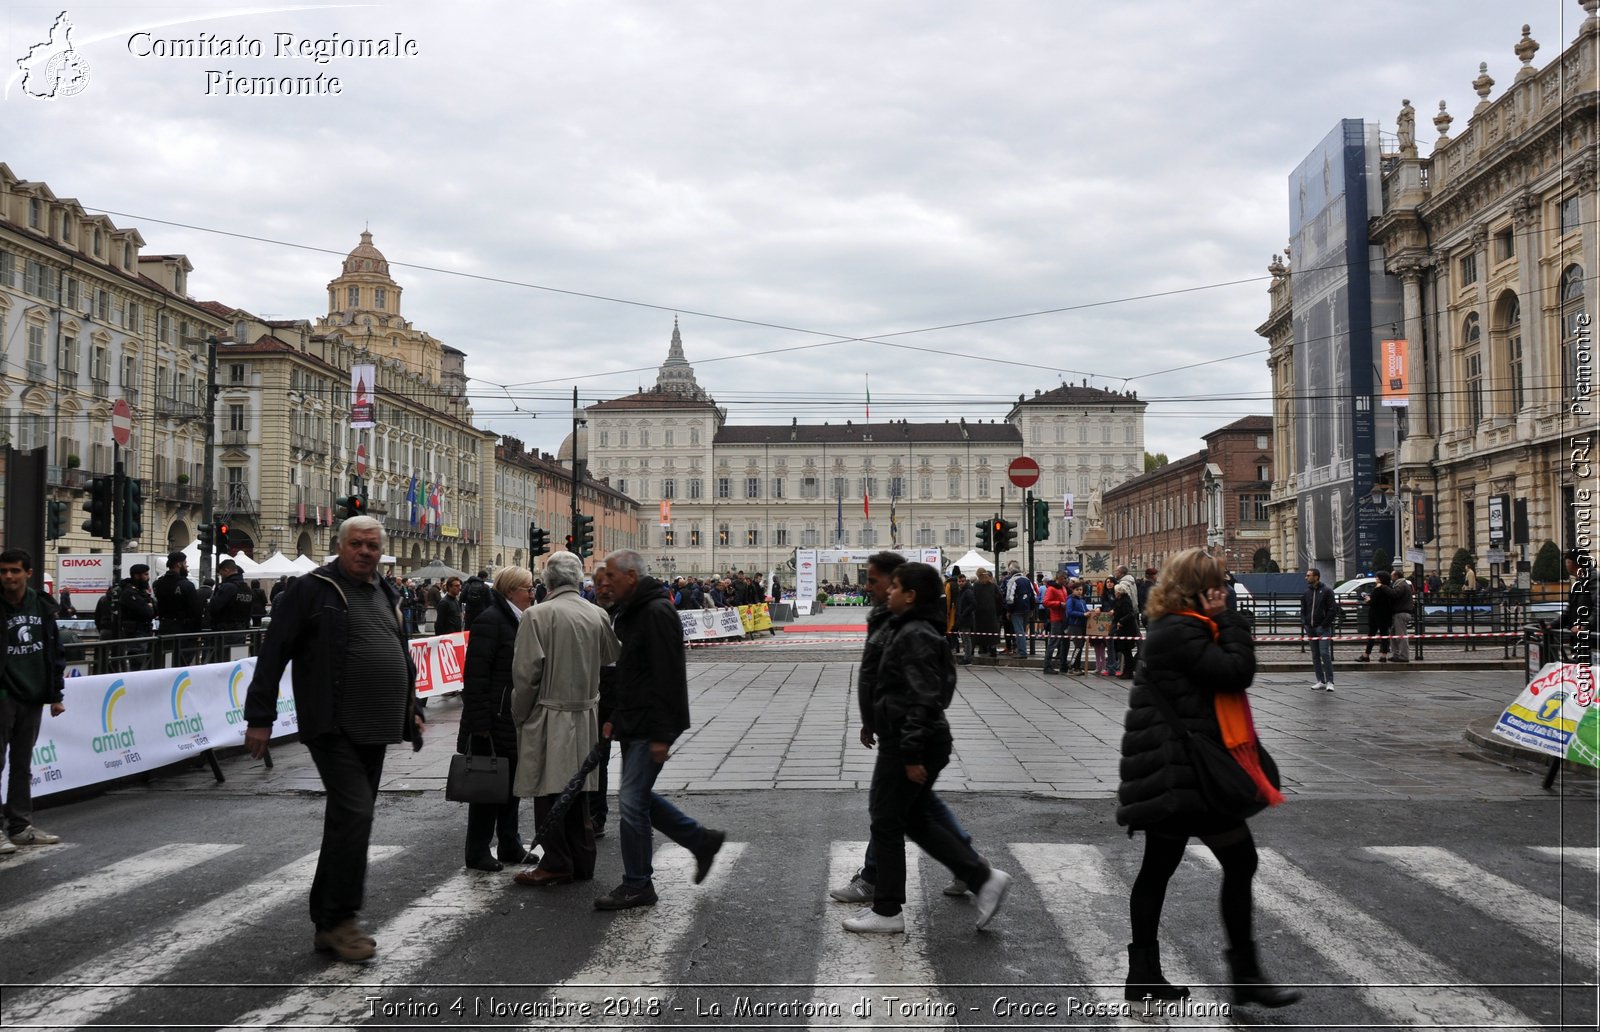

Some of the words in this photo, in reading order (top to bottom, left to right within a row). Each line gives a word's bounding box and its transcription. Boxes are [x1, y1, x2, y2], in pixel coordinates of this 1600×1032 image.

[62, 559, 102, 567] GIMAX
[165, 712, 205, 738] amiat
[225, 704, 245, 725] ami
[92, 725, 136, 754] amiat
[32, 738, 58, 766] iat
[104, 760, 123, 768] Gruppo
